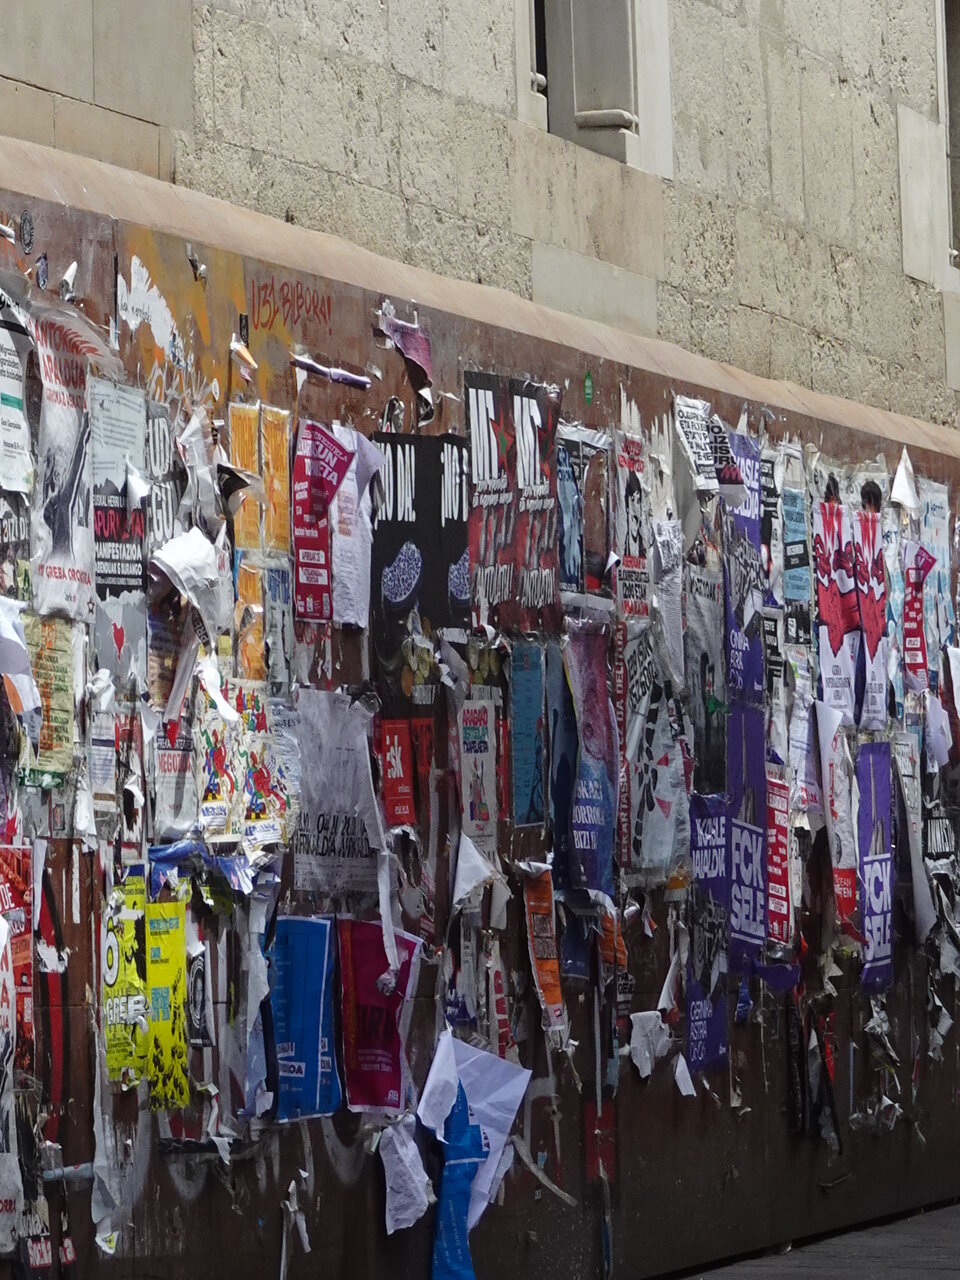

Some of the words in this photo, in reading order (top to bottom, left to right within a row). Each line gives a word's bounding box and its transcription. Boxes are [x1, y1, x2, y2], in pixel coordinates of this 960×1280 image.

[731, 826, 765, 890] FCK
[731, 882, 766, 938] SELE
[864, 913, 892, 960] SELE
